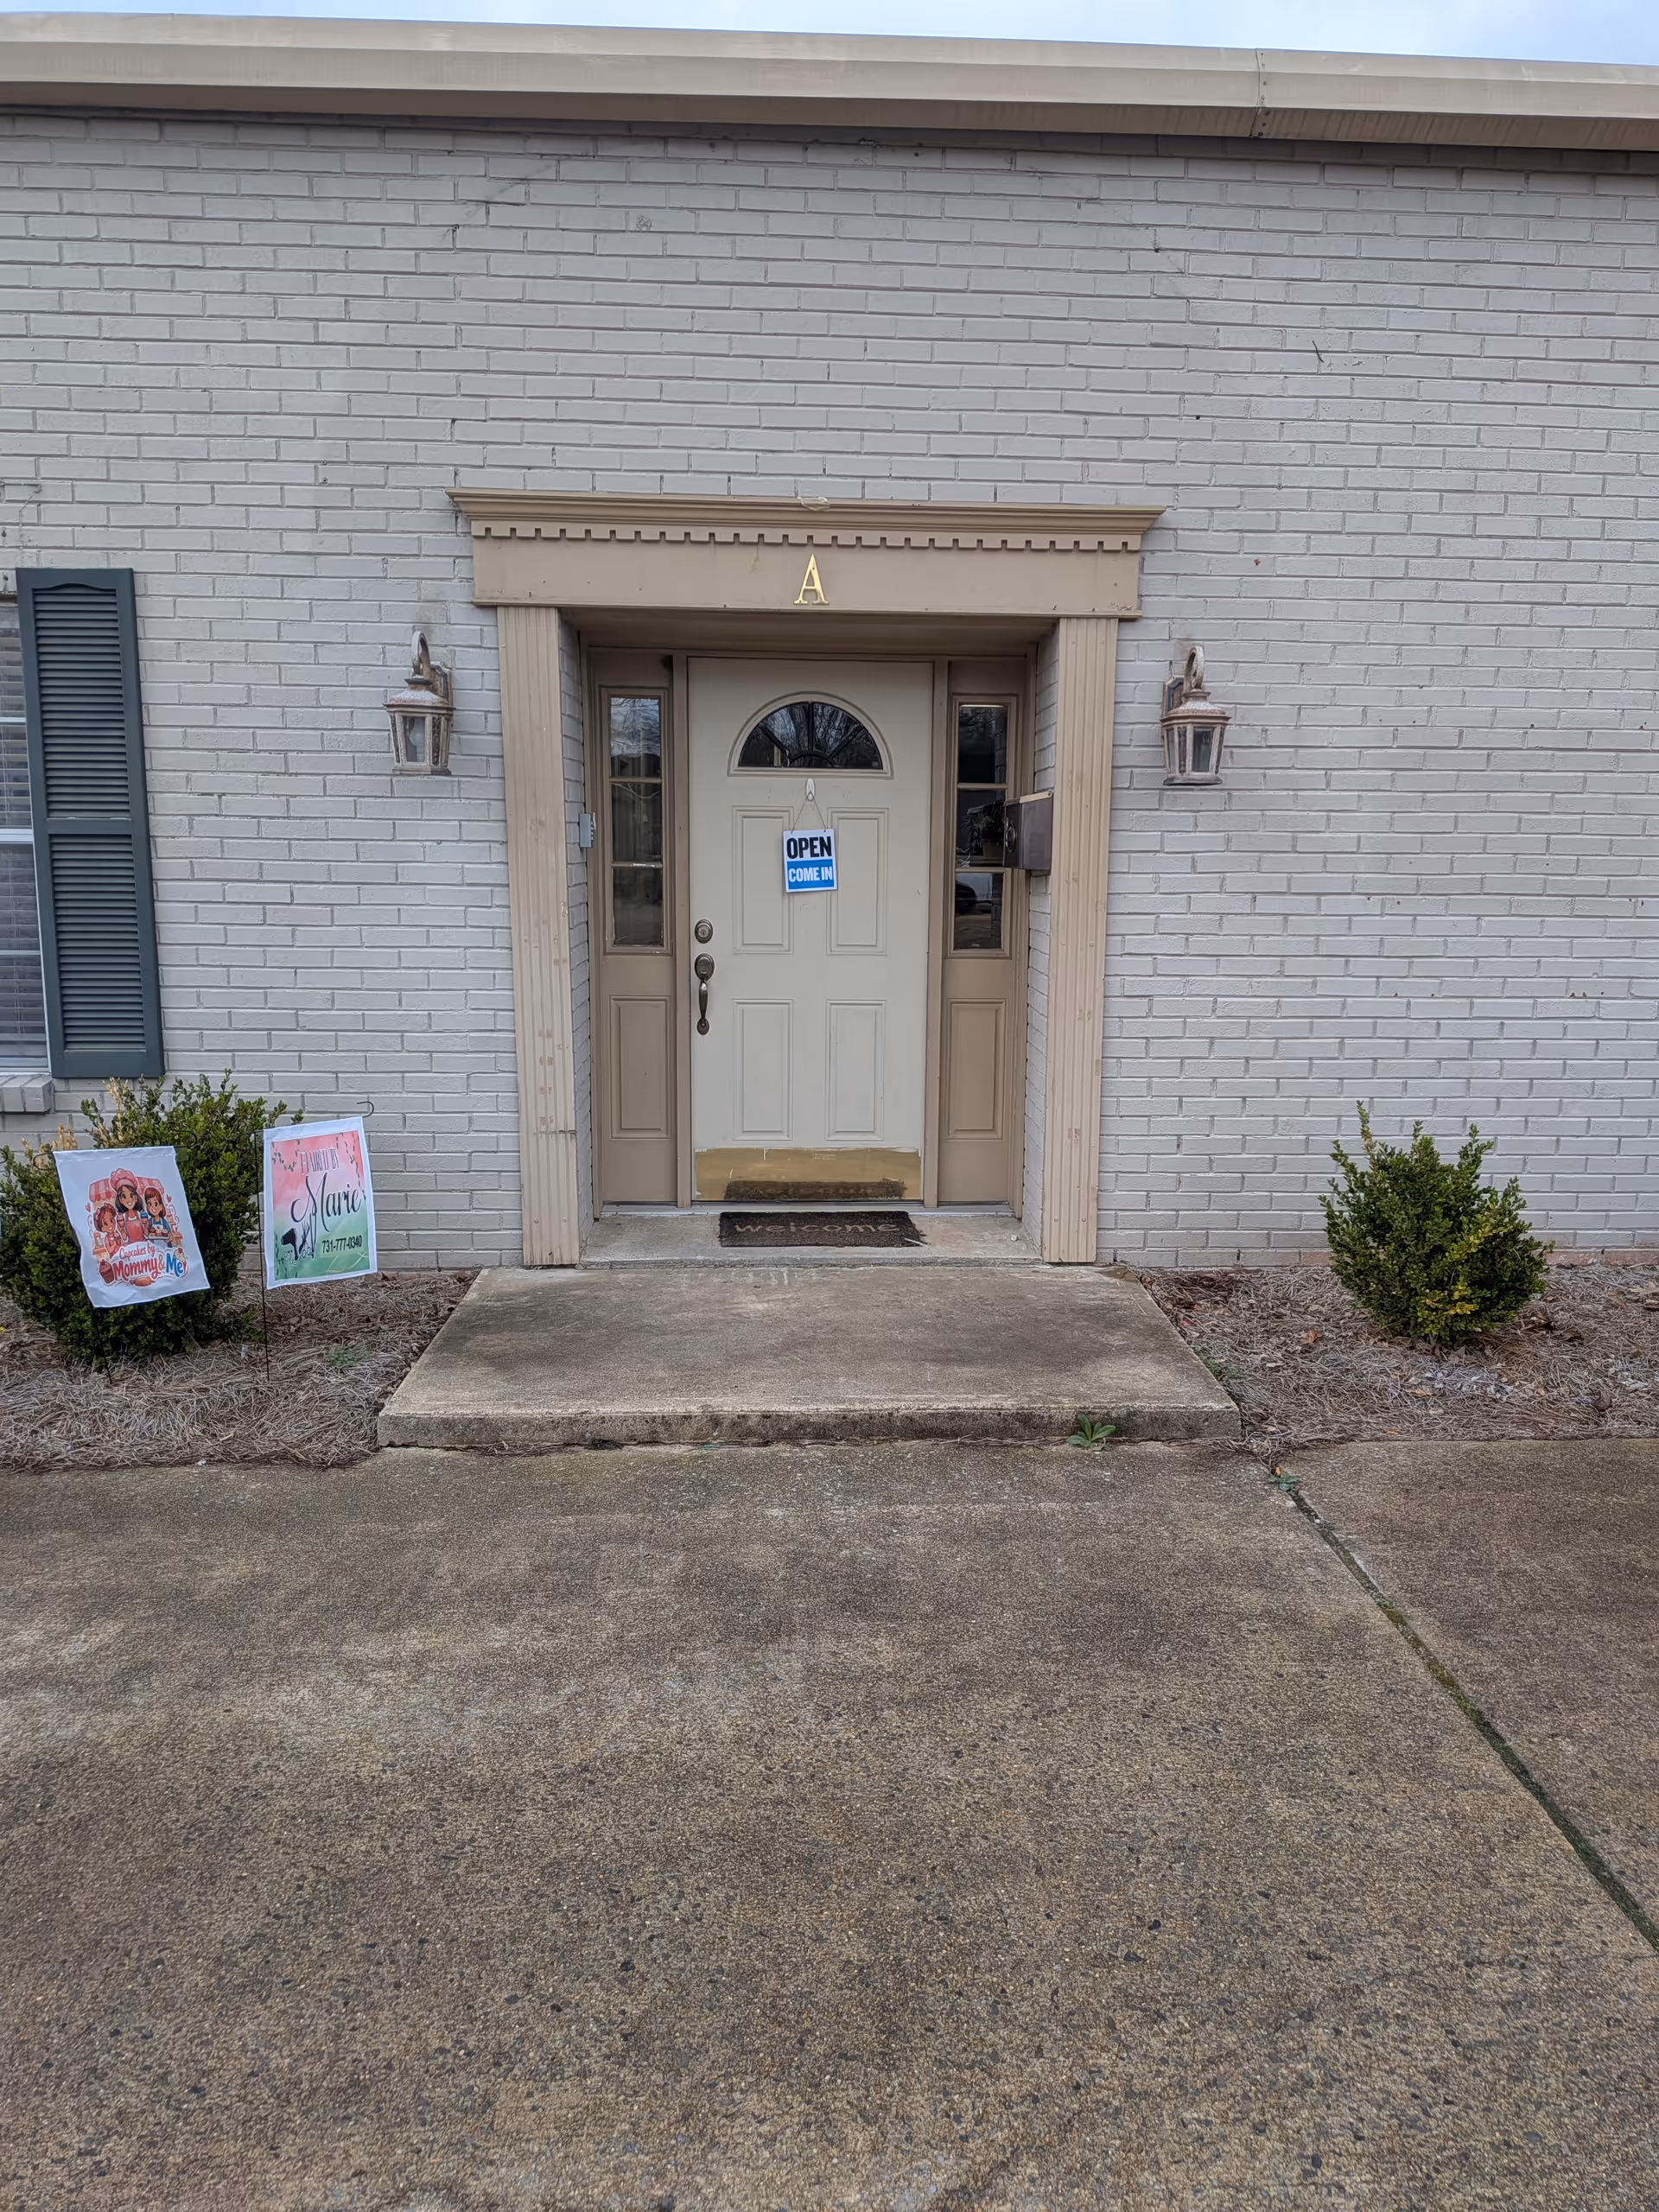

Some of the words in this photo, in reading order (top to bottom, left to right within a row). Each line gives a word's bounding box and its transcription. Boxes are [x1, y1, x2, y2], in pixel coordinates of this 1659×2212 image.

[794, 554, 829, 605] A
[786, 836, 832, 859] OPEN
[788, 867, 820, 882] COME
[821, 866, 833, 880] IN
[330, 1147, 339, 1169] BY
[290, 1173, 362, 1232] Marie
[734, 1222, 899, 1232] welcome
[119, 1246, 147, 1261] Cupcakes
[147, 1242, 156, 1257] by
[321, 1234, 363, 1254] 731-777-0340
[113, 1258, 162, 1281] Mommy
[158, 1254, 166, 1271] &
[166, 1253, 183, 1277] Me
